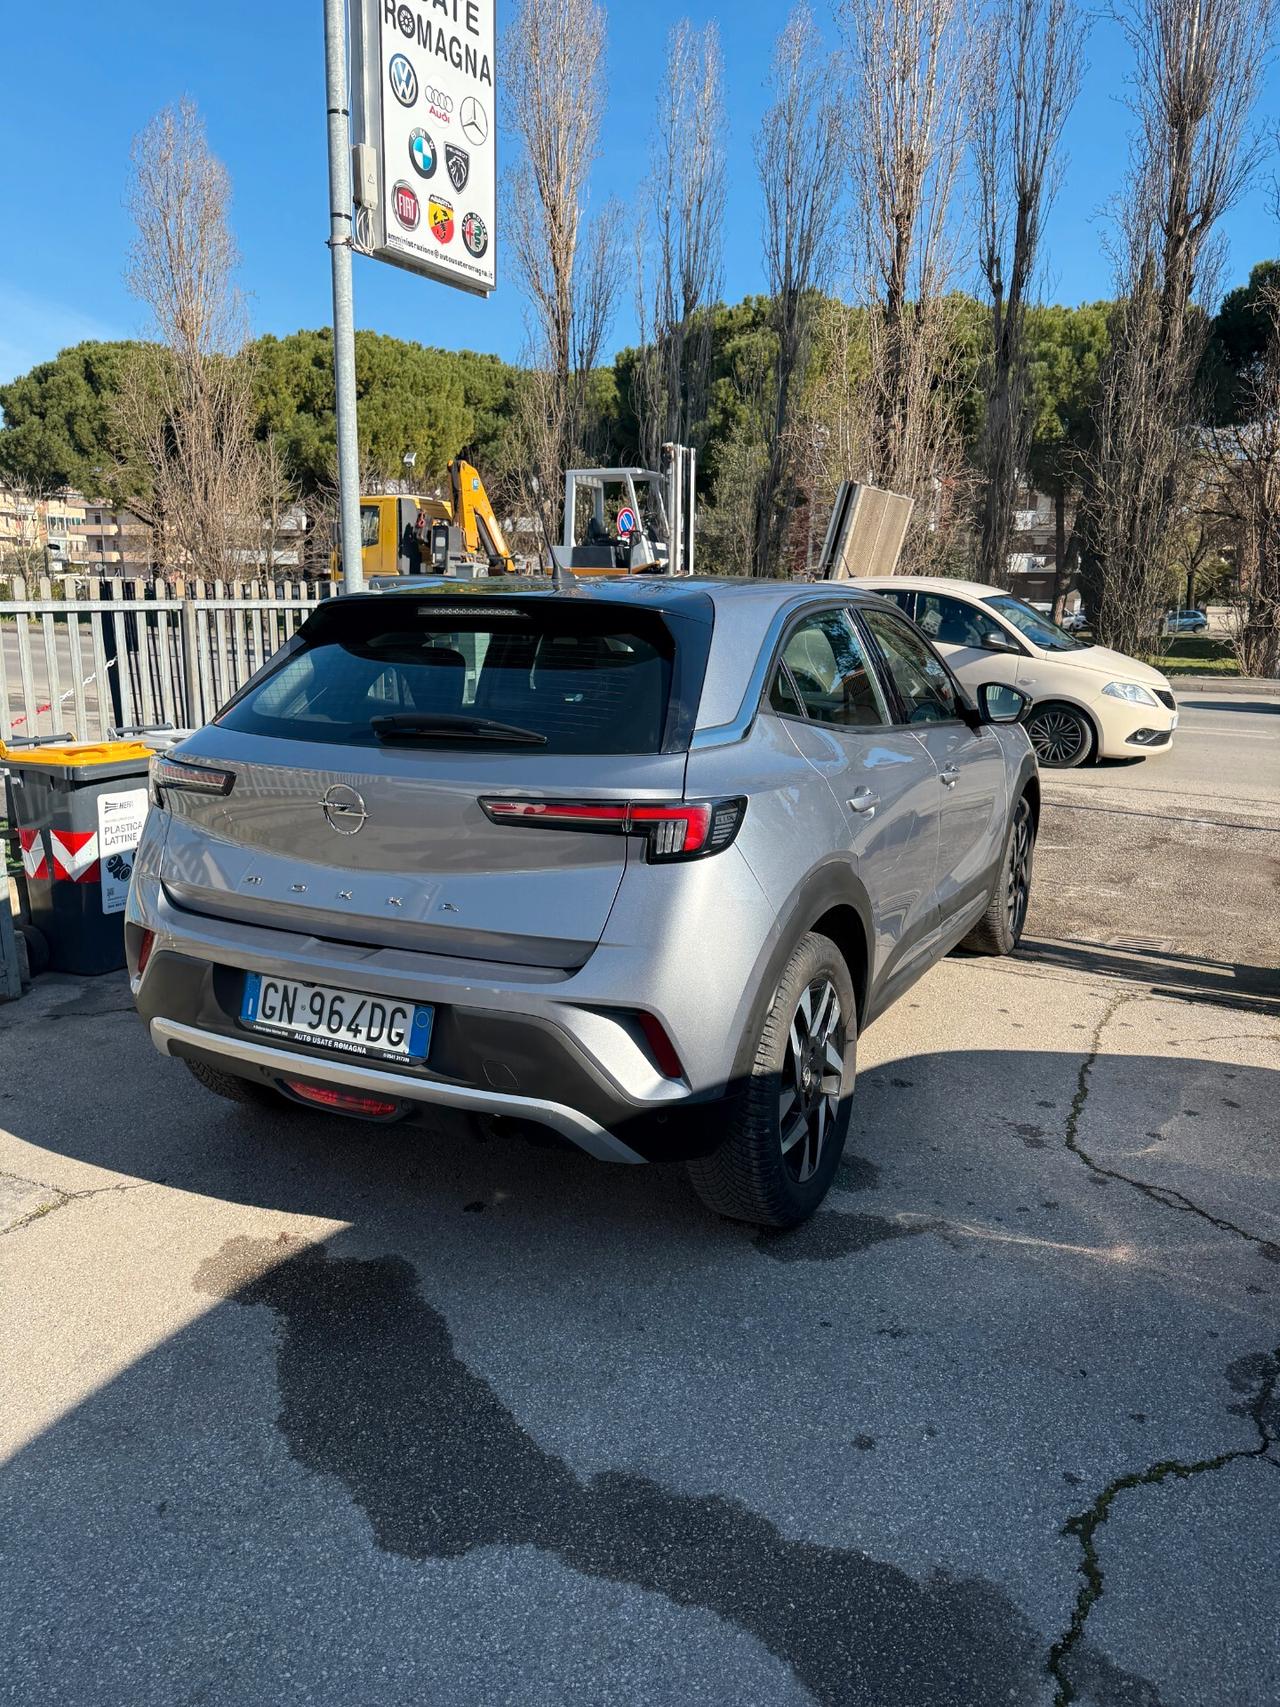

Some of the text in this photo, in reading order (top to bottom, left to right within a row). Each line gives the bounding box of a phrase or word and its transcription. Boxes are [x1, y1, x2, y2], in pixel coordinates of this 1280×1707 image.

[384, 0, 492, 87] ROMAGNA
[429, 105, 450, 123] Audi
[410, 128, 435, 150] BMW
[398, 192, 416, 220] FIAT
[104, 821, 142, 835] PLASTICA
[105, 833, 137, 846] LATTINE
[261, 982, 298, 1025] GN
[307, 991, 408, 1047] 964DG
[294, 1032, 367, 1055] AUTO USATE ROMAGNA
